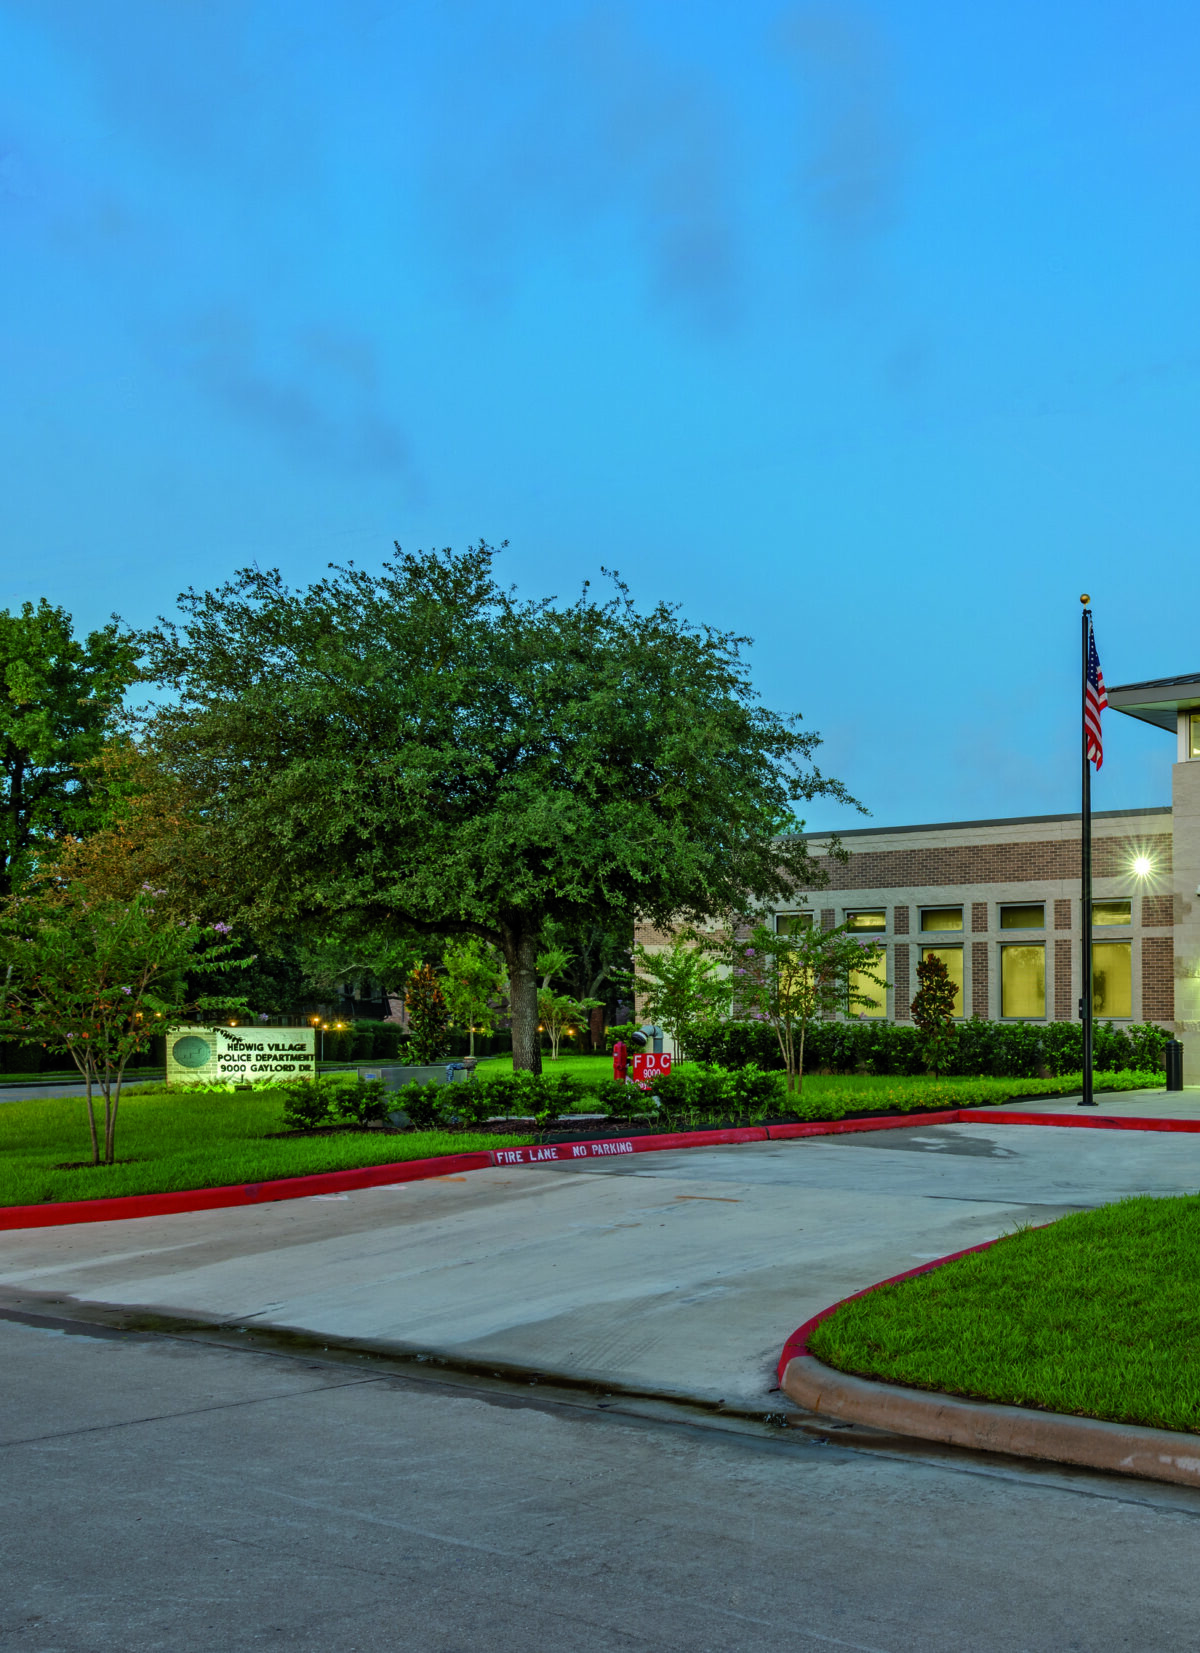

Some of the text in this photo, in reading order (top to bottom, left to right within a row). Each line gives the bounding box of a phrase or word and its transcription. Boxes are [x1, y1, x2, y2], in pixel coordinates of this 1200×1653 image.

[227, 1043, 307, 1052] HEDWIG VILLAGE
[217, 1054, 315, 1062] POLICE DEPARTMENT
[220, 1064, 314, 1072] 9000 GAYLORD DR.
[496, 1141, 633, 1163] FIRE LANE NO PARKING
